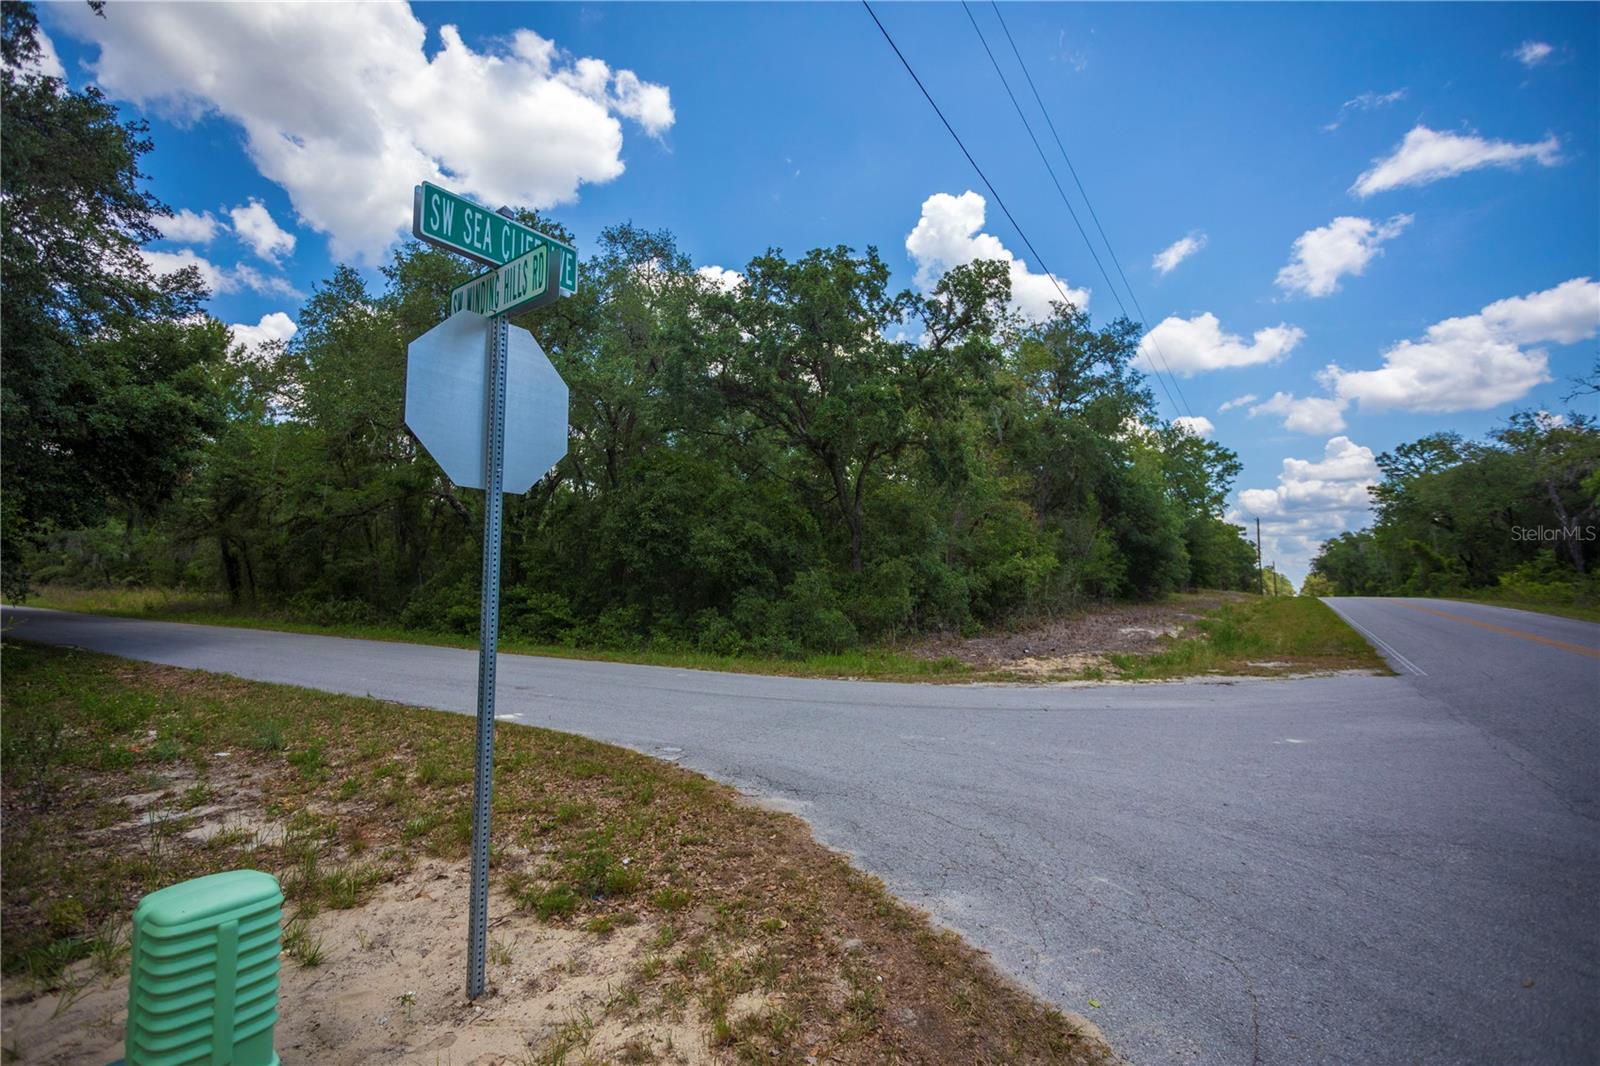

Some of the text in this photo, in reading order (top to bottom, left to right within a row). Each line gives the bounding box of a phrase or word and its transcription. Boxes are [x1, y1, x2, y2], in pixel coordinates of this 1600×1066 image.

[430, 194, 454, 236] SW
[463, 208, 492, 253] SEA
[502, 225, 542, 261] CLIF
[467, 271, 499, 315] WINDING
[503, 259, 528, 304] HILLS
[532, 252, 544, 292] RD
